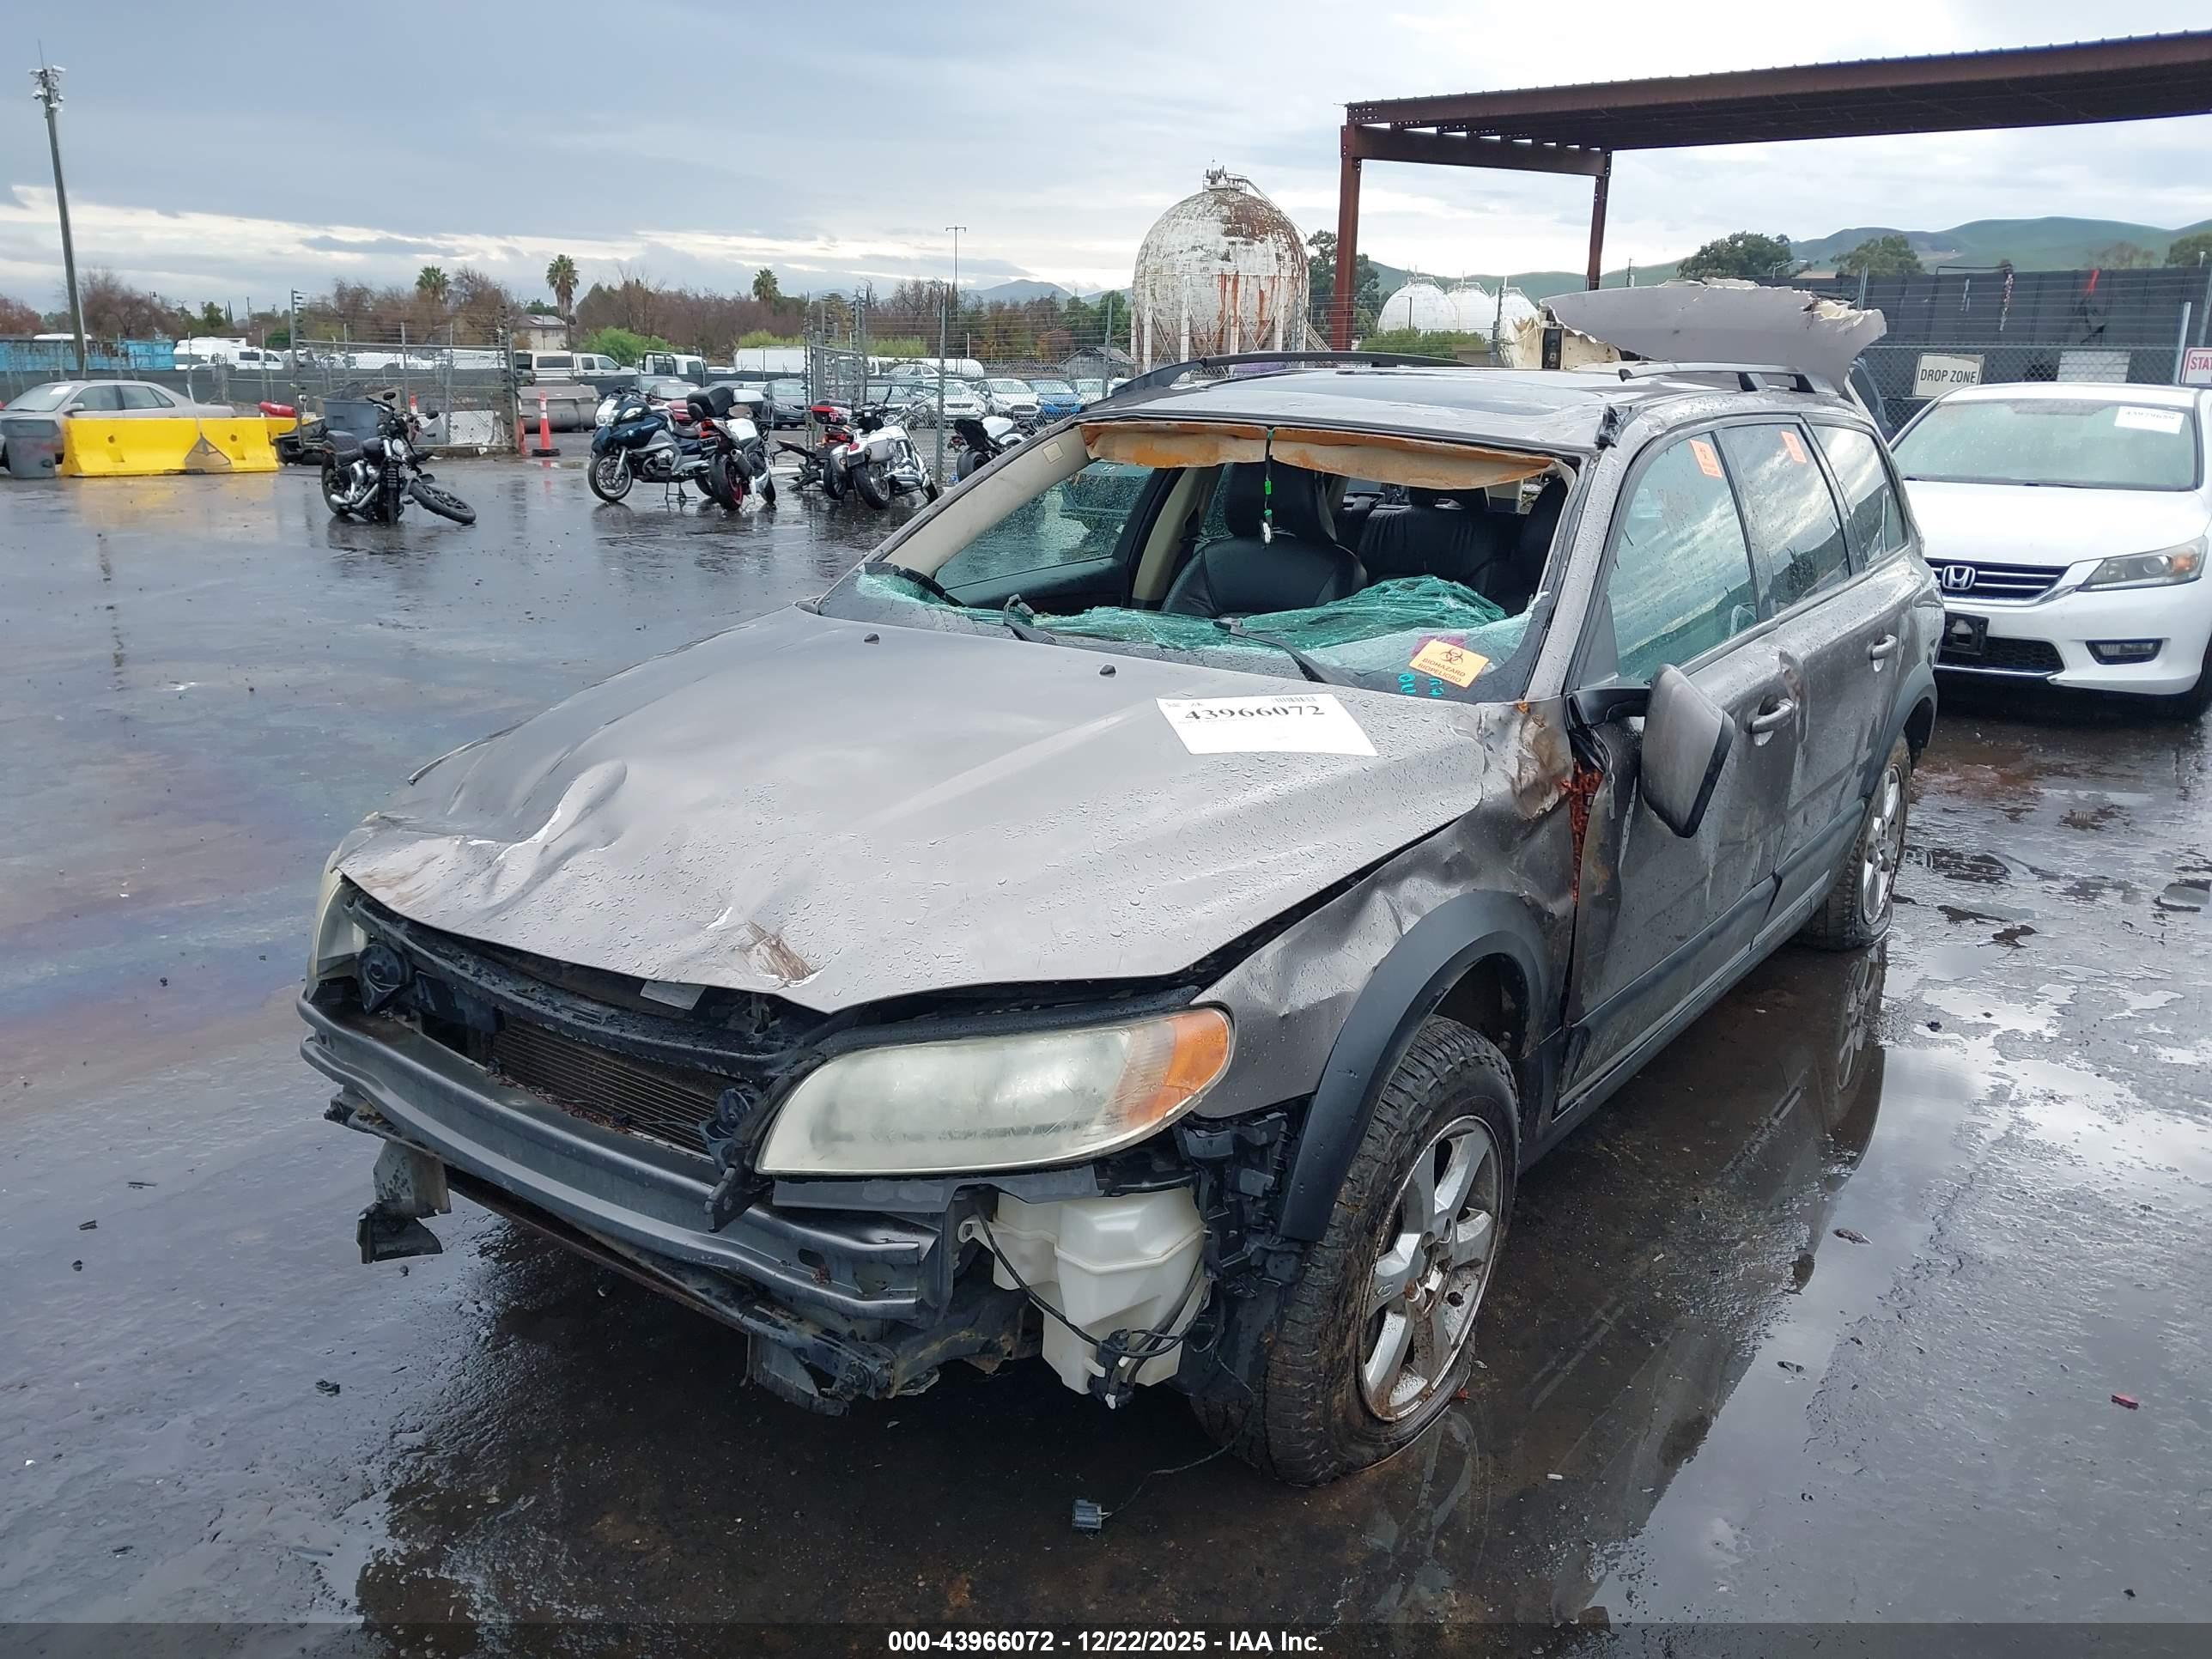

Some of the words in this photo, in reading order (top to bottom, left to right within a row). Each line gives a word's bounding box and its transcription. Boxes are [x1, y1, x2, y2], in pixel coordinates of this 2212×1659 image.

[1920, 368, 1948, 382] DROP
[1949, 370, 1978, 384] ZONE
[1417, 663, 1462, 684] BIOPELIGRO
[1421, 658, 1466, 678] BIOHAZARD
[1184, 705, 1325, 720] 43966072
